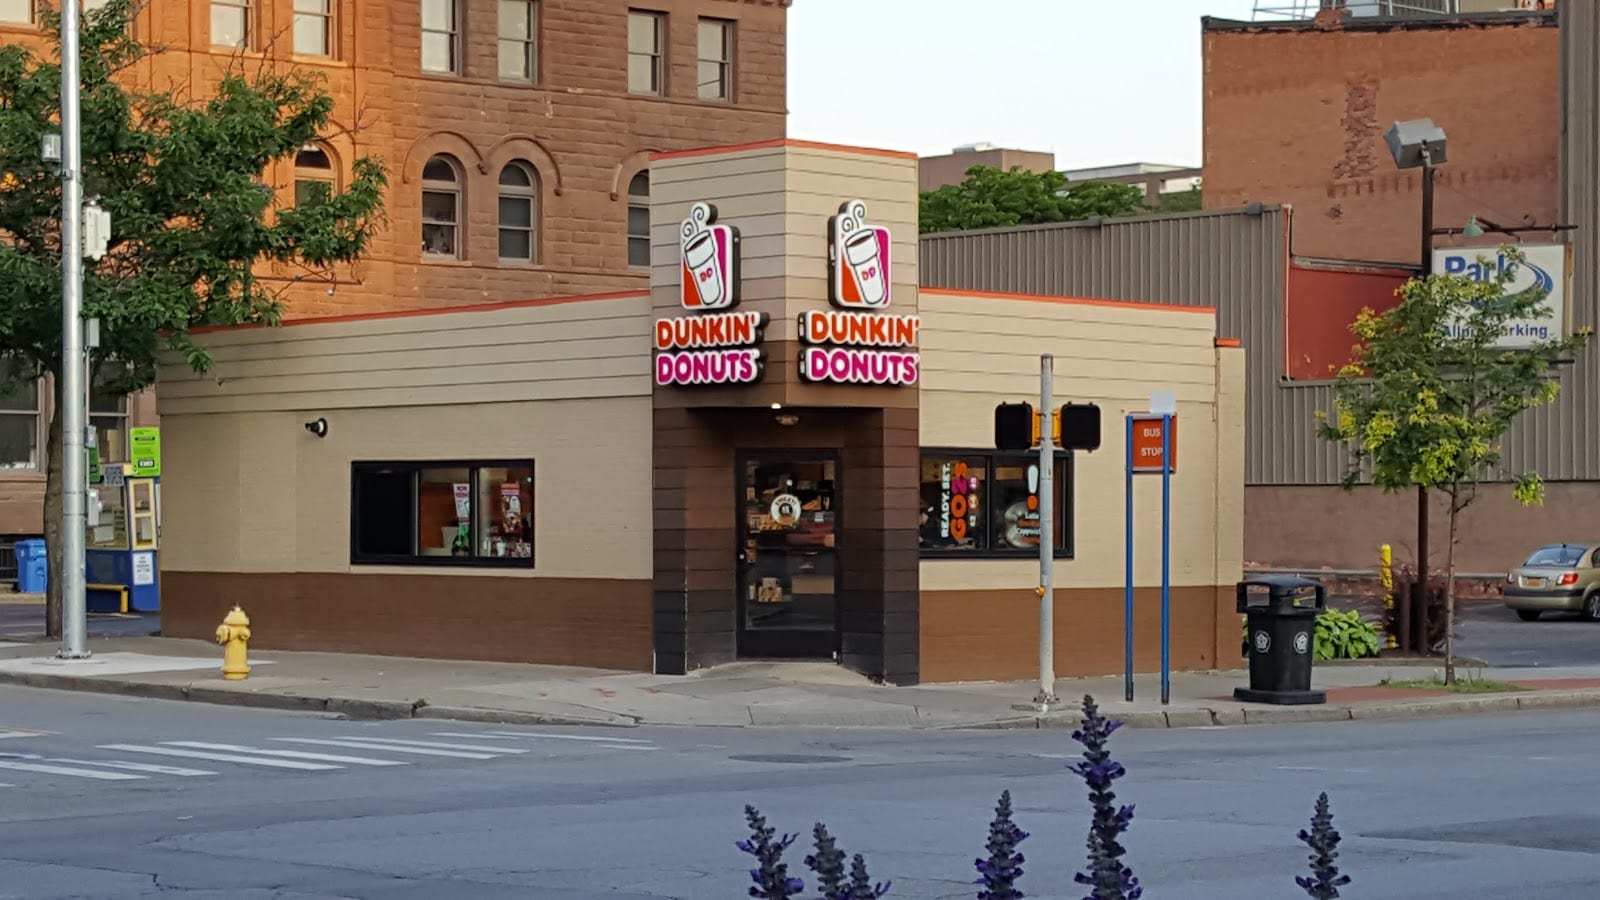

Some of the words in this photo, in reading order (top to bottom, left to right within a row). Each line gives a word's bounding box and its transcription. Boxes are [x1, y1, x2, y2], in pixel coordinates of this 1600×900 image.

[1445, 254, 1516, 283] Park
[656, 315, 756, 347] DUNKIN'
[811, 312, 919, 345] DUNKIN'
[656, 352, 754, 384] DONUTS
[811, 350, 918, 383] DONUTS
[1143, 428, 1161, 437] BUS
[1141, 447, 1163, 456] STOP
